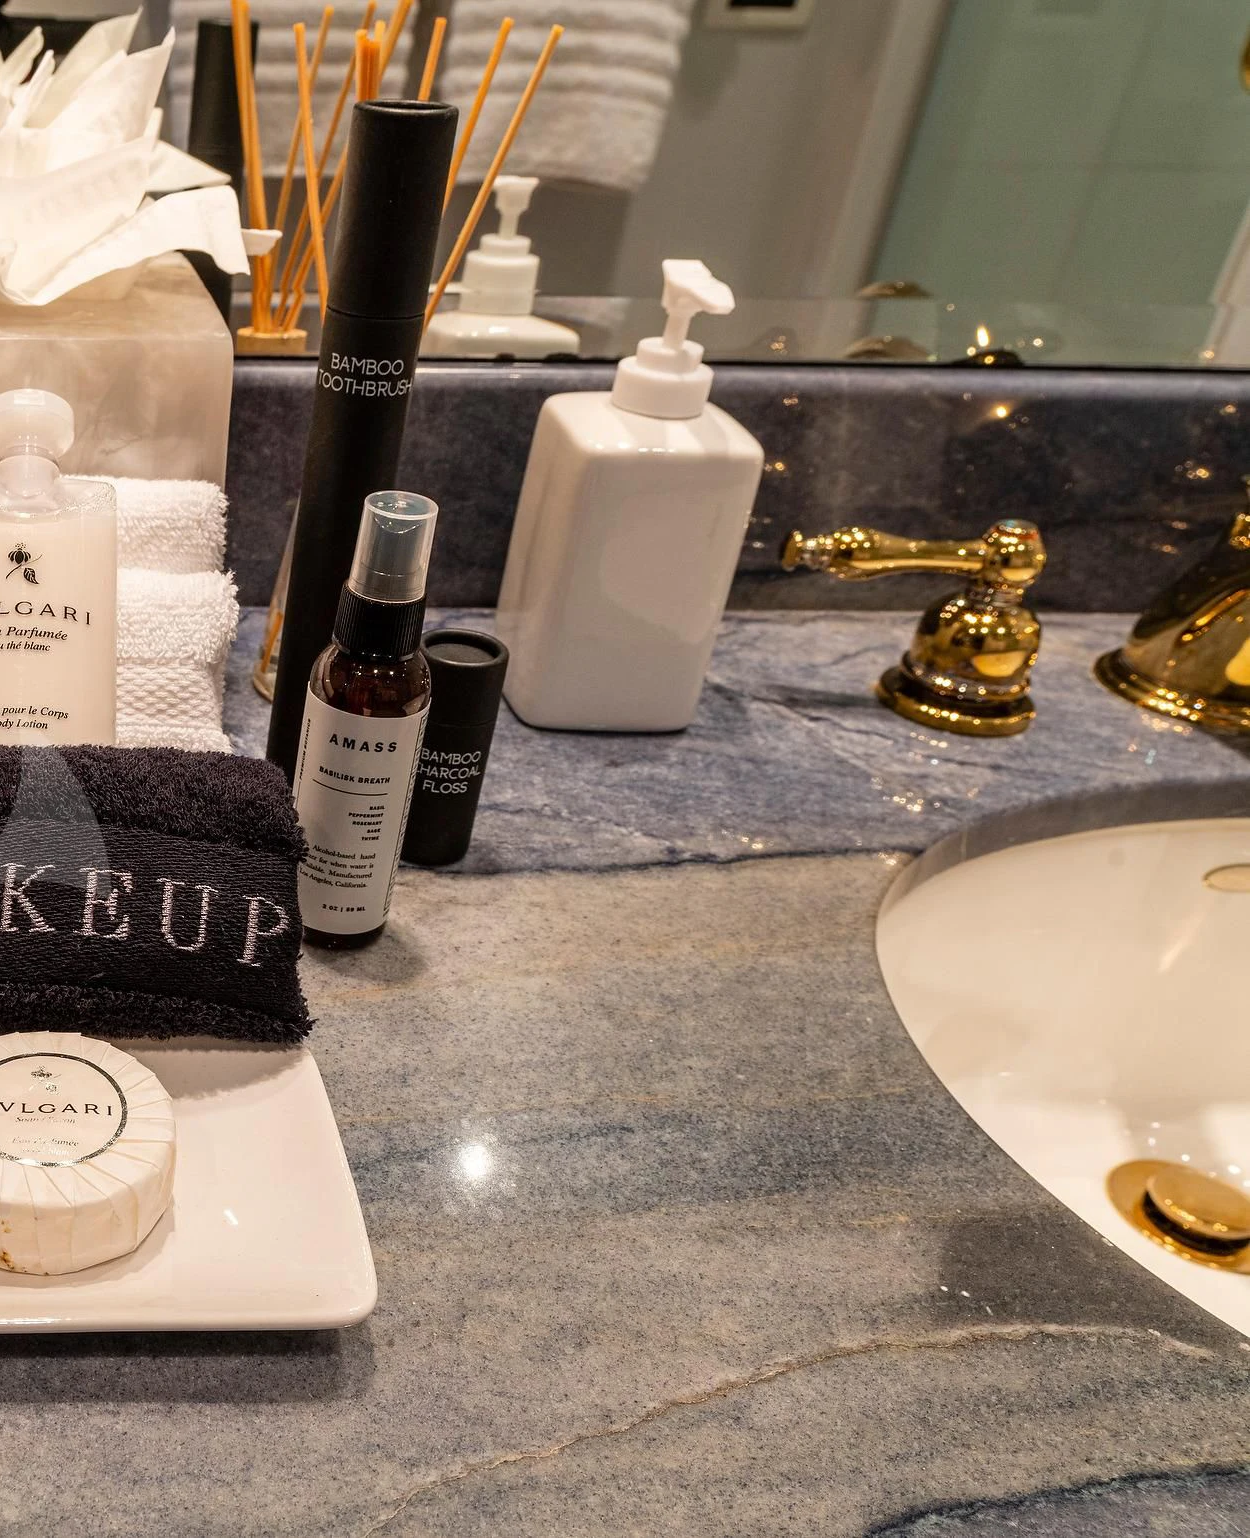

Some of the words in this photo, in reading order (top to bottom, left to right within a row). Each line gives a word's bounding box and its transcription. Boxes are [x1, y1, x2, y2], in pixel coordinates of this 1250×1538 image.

[330, 352, 404, 376] BAMBOO
[318, 368, 413, 397] TOOTHBRUSH
[6, 626, 68, 641] Parfumée
[6, 641, 22, 650] thé
[23, 641, 51, 652] blanc
[1, 706, 26, 717] pour
[28, 706, 38, 715] le
[40, 706, 69, 720] Corps
[16, 718, 49, 730] Lotion
[329, 733, 398, 753] AMASS
[420, 747, 482, 765] BAMBOO
[319, 765, 355, 783] BASILISK
[358, 776, 391, 785] BREATH
[422, 779, 469, 794] FLOSS
[312, 844, 356, 860] Alcohol-based
[330, 861, 347, 869] when
[328, 869, 373, 879] Manufactured
